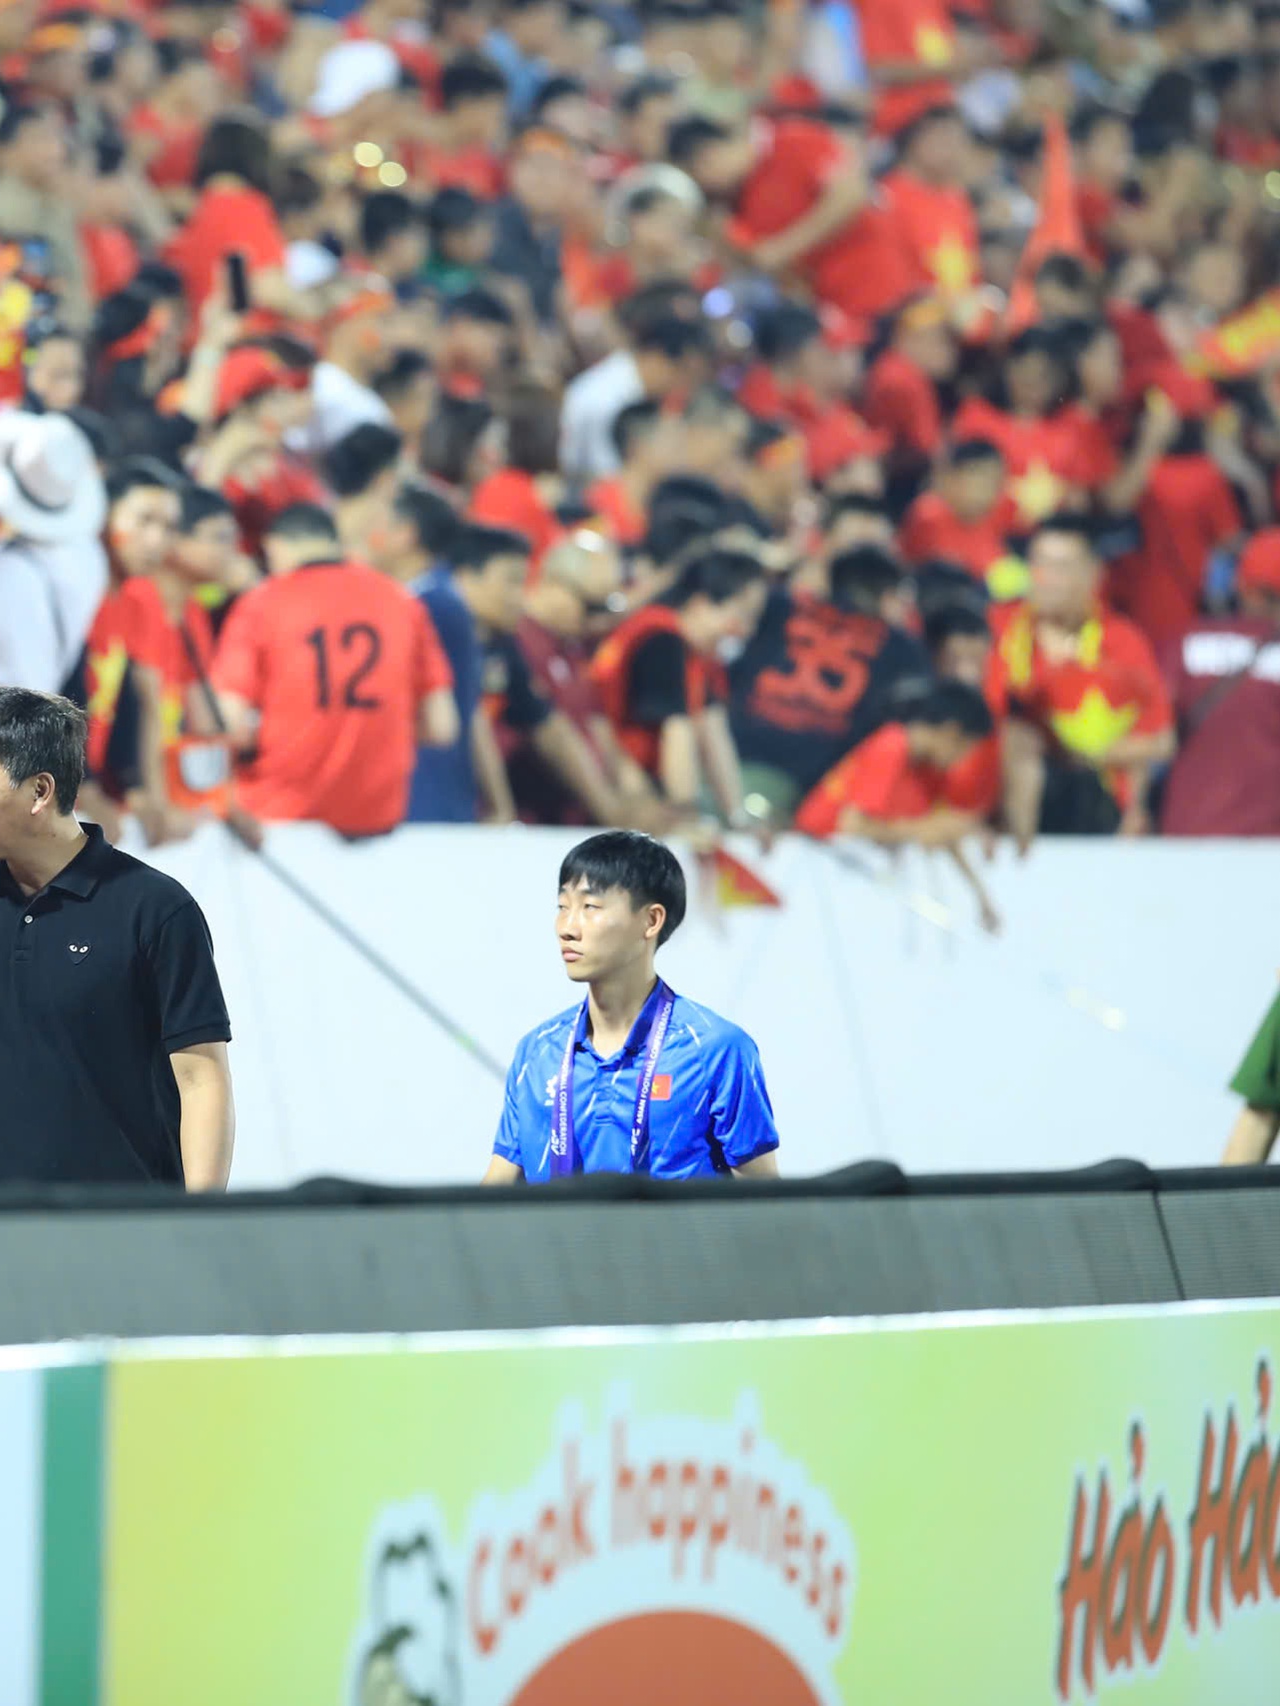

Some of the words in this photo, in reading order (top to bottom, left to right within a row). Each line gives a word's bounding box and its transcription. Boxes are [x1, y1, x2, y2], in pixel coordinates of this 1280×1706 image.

[306, 621, 384, 710] 12
[649, 1001, 673, 1059] CONFEDERATION
[640, 1060, 656, 1099] FOOTBALL
[636, 1099, 647, 1124] ASIAN
[467, 1440, 596, 1657] Cook
[610, 1419, 846, 1638] happiness
